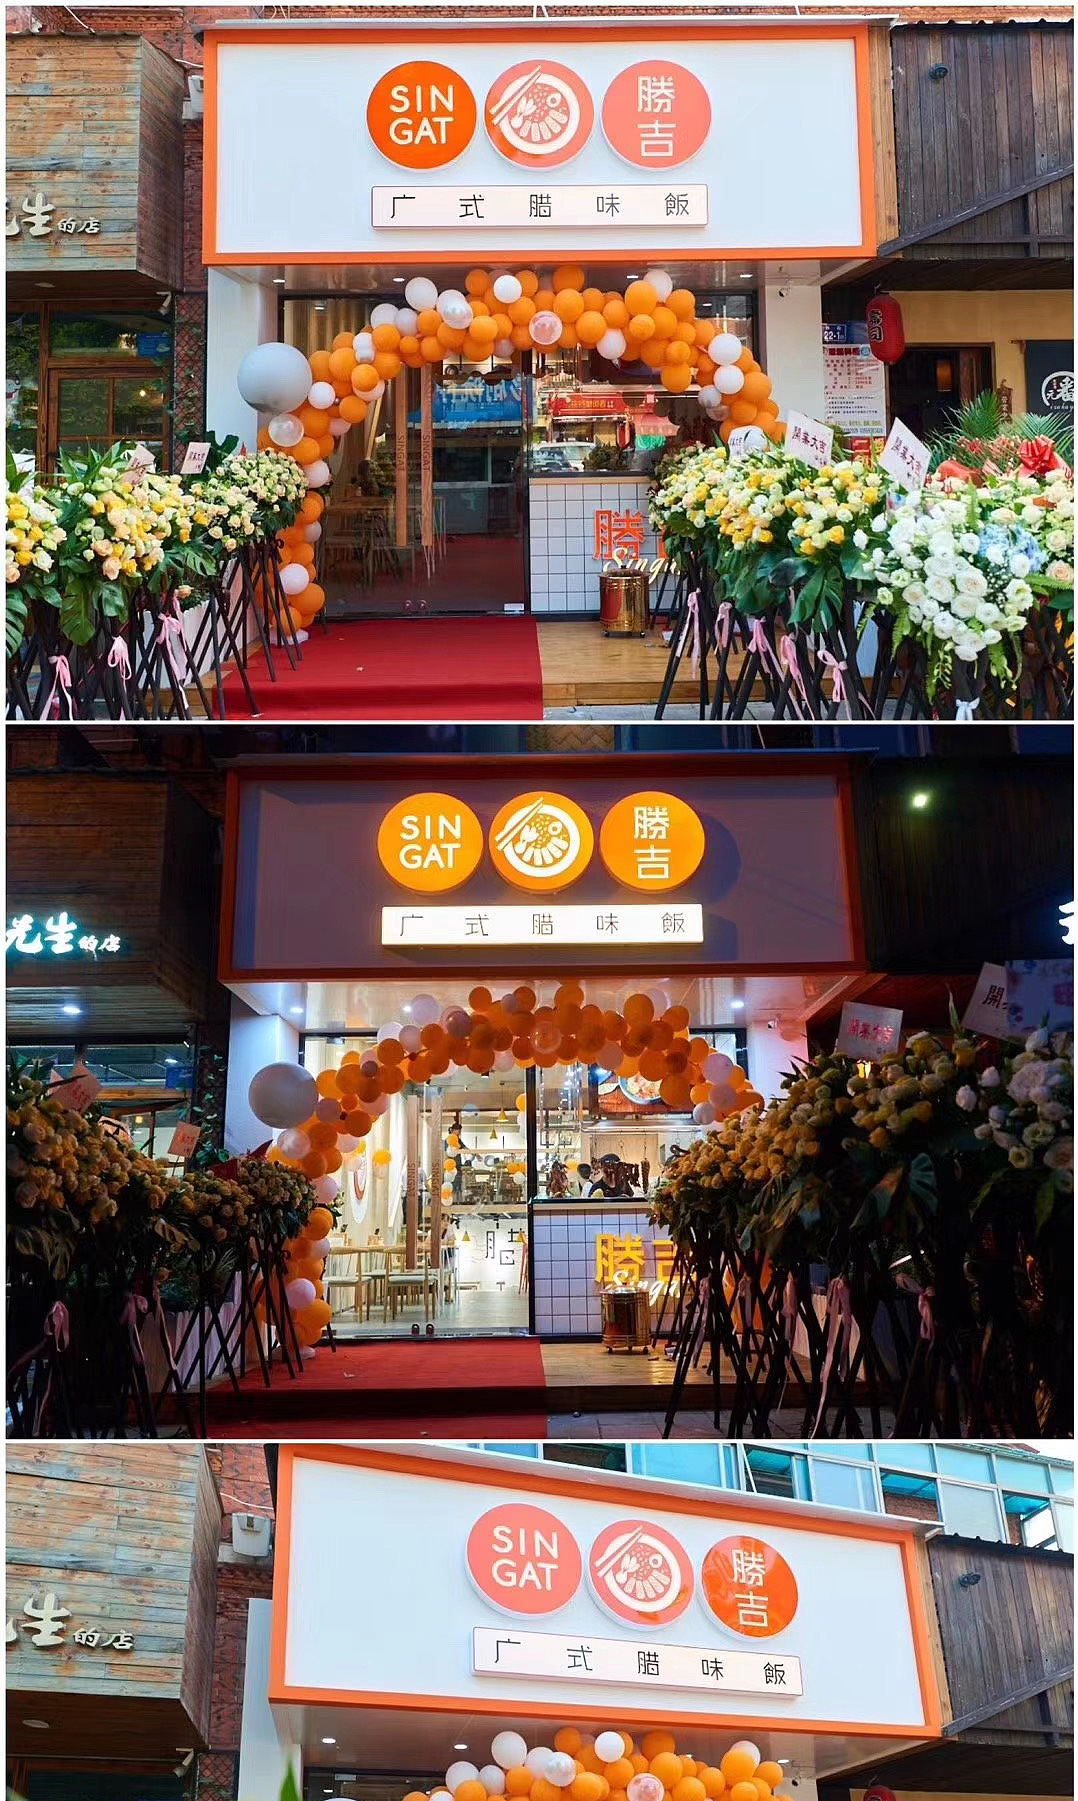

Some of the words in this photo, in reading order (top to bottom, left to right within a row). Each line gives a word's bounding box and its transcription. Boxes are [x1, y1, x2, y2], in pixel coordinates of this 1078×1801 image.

[390, 84, 455, 114] SIN
[389, 116, 454, 146] GAT
[637, 75, 677, 158] 勝吉
[6, 192, 101, 237] 生的店
[390, 192, 690, 220] 广式腊味飯
[399, 814, 462, 841] SIN
[633, 805, 672, 880] 勝吉
[399, 843, 462, 870] GAT
[399, 911, 687, 937] 广式腊味飯
[491, 1525, 559, 1559] SIN
[491, 1558, 559, 1591] GAT
[730, 1549, 769, 1628] 勝吉
[6, 1592, 136, 1650] 生的店
[494, 1638, 787, 1686] 广式腊味飯
